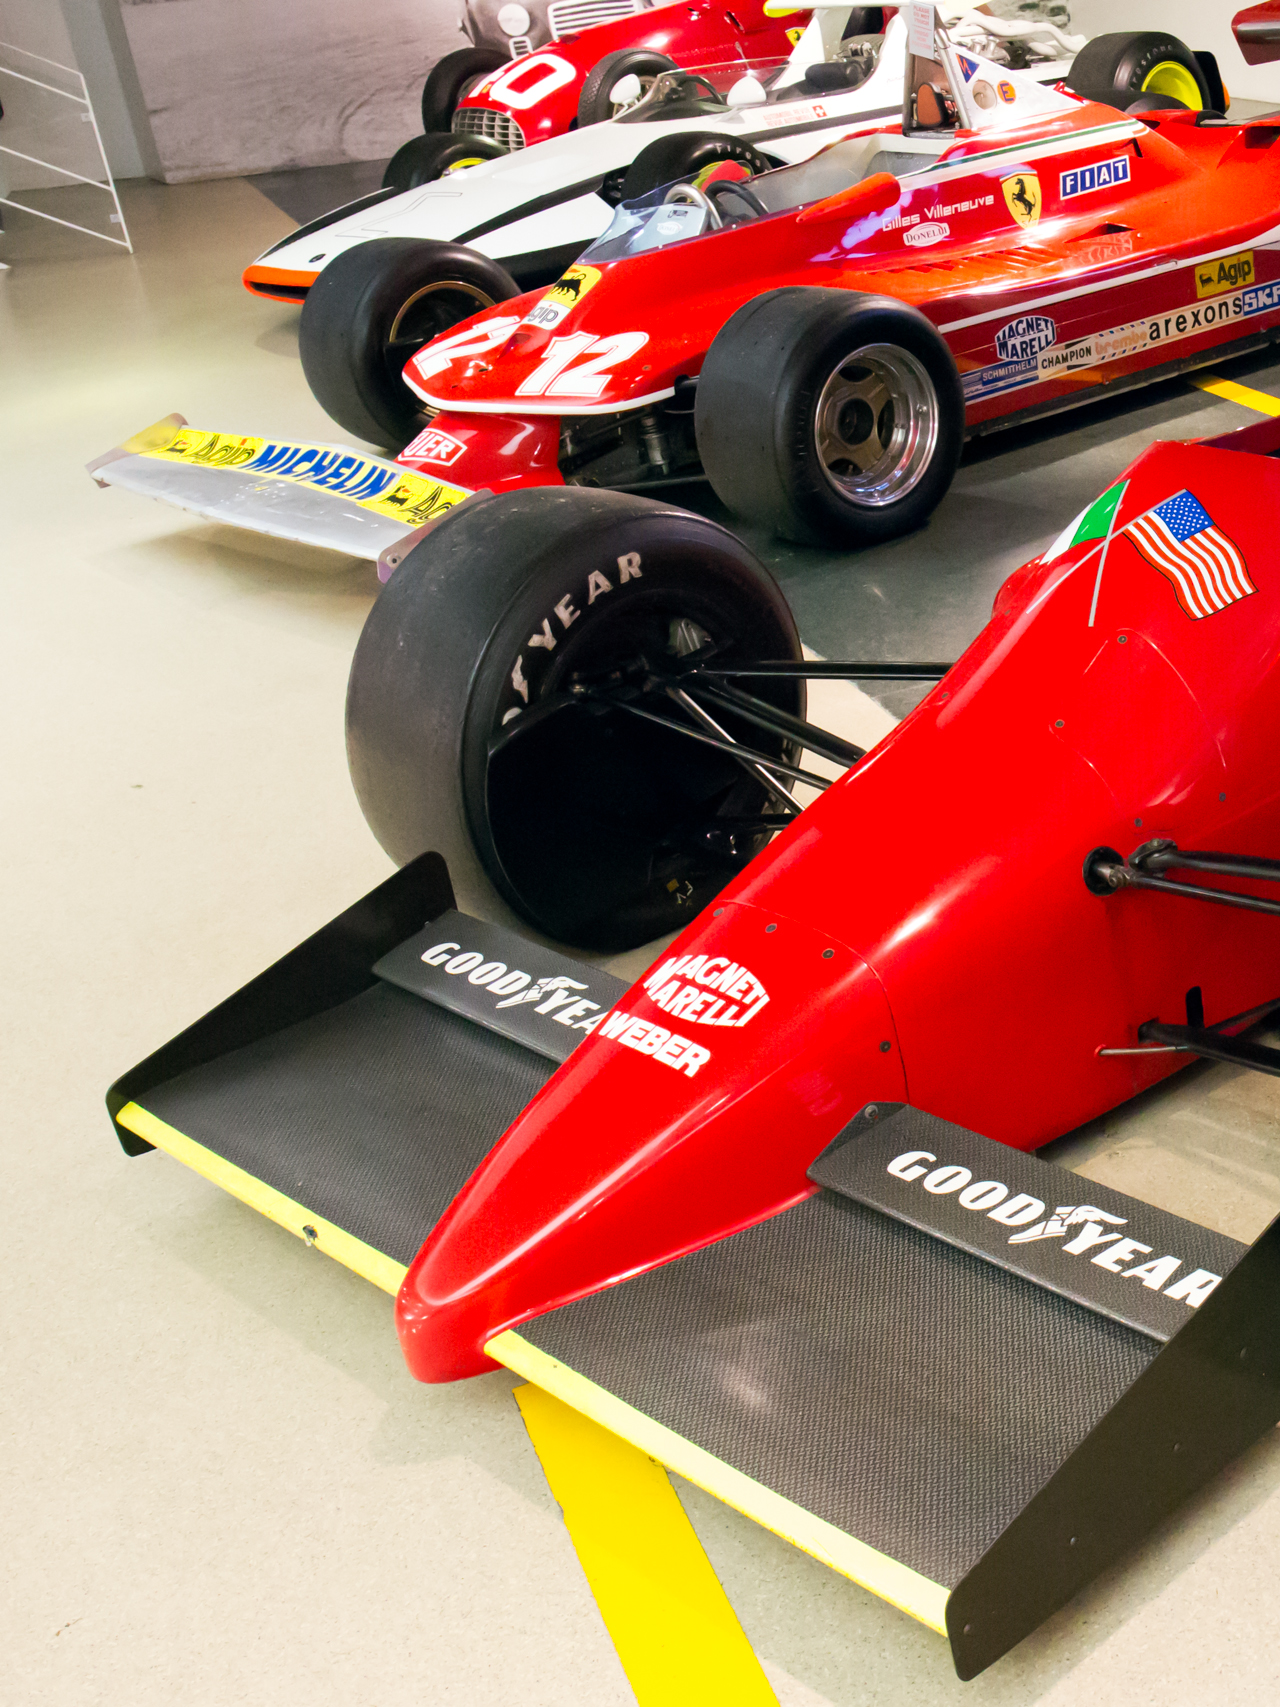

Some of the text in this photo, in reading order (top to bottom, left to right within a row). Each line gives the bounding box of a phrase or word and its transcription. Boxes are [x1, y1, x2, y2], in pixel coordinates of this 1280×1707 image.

[1064, 159, 1127, 194] FIAT
[882, 194, 995, 232] Gilles Villeneuve
[1217, 256, 1252, 286] Agip
[1149, 297, 1243, 342] arexons
[514, 331, 650, 397] 12
[1041, 345, 1092, 369] CHAMPION
[403, 430, 456, 459] UER
[186, 435, 454, 525] Agip MICHELIN Ag
[598, 1010, 712, 1078] WEBER
